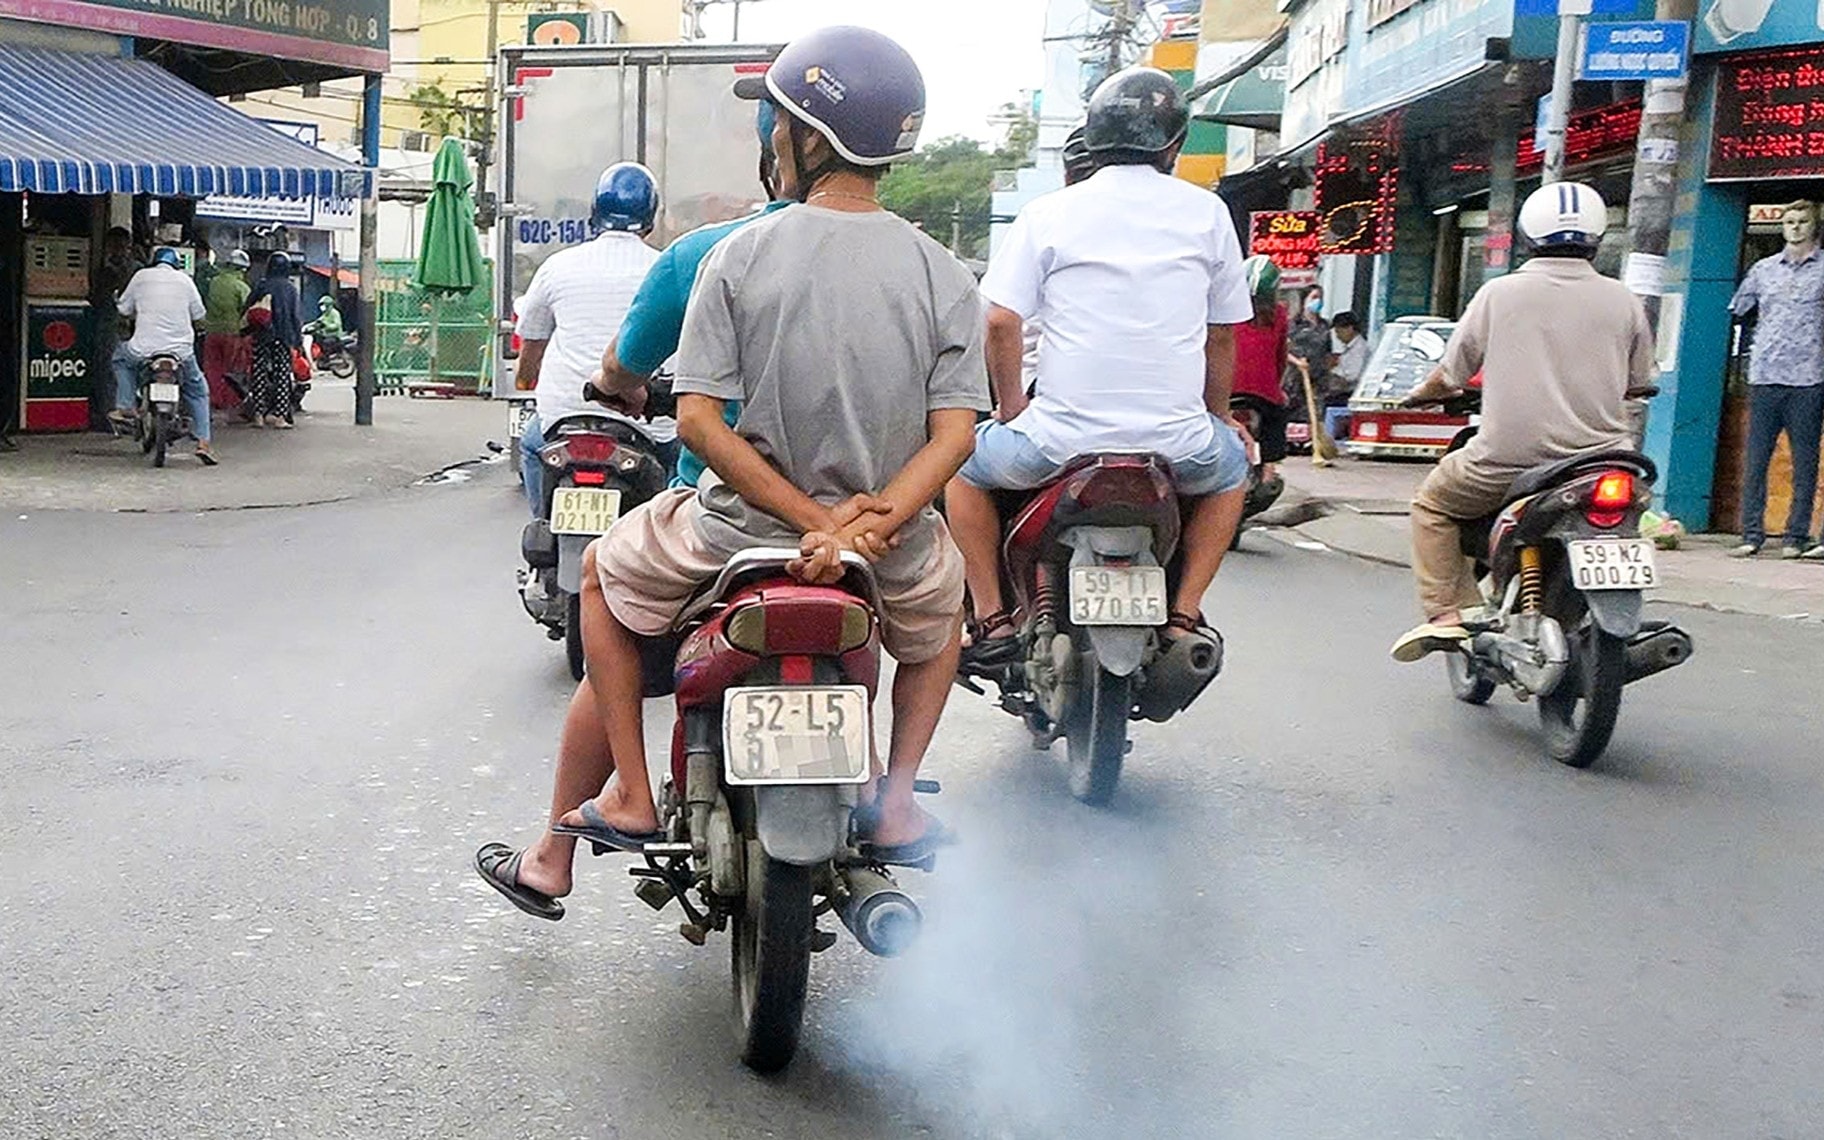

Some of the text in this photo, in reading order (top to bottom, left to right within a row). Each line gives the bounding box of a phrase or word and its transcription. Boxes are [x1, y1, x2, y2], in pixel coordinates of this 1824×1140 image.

[366, 17, 378, 41] 8
[1269, 213, 1307, 233] Sửa
[30, 353, 86, 384] mipec
[746, 693, 844, 732] 52-L5
